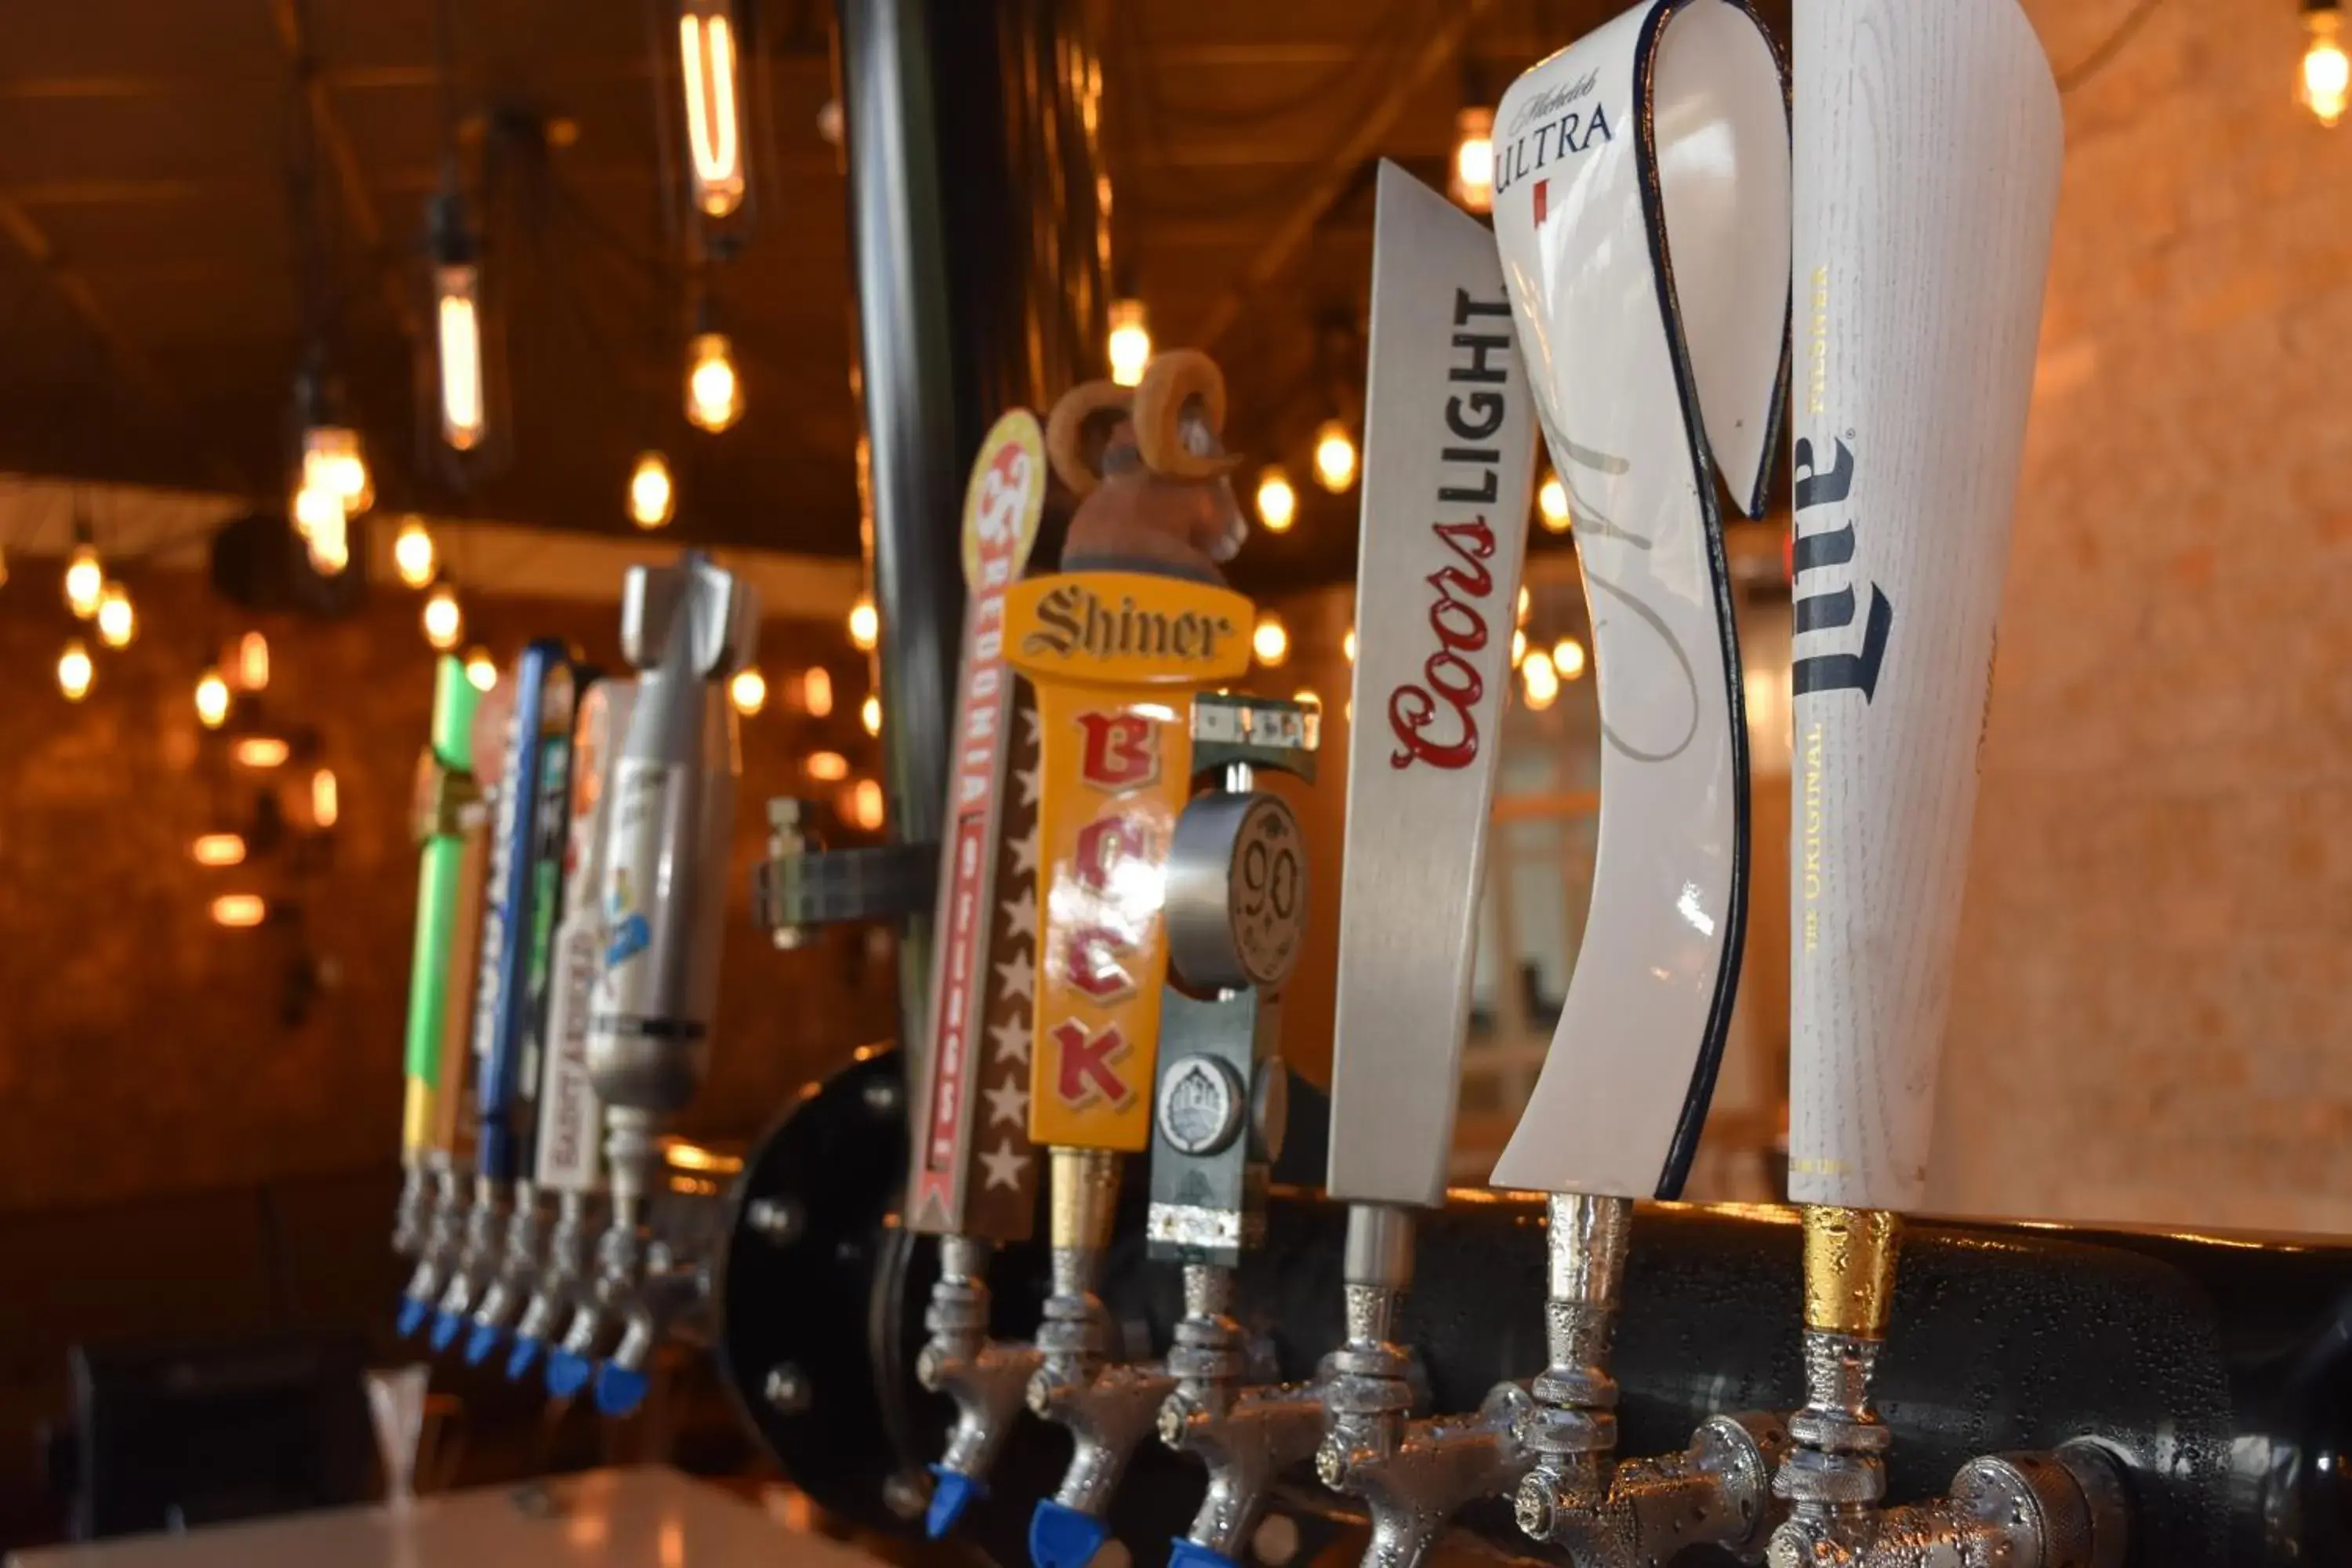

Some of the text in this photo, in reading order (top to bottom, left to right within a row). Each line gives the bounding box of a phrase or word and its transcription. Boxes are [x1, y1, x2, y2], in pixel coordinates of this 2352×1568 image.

[1494, 100, 1613, 195] ULTRA
[1388, 287, 1512, 770] Coors LIGHT
[1023, 583, 1235, 662] Shiner
[1804, 722, 1823, 897] ORIGINAL
[1243, 840, 1299, 920] 90
